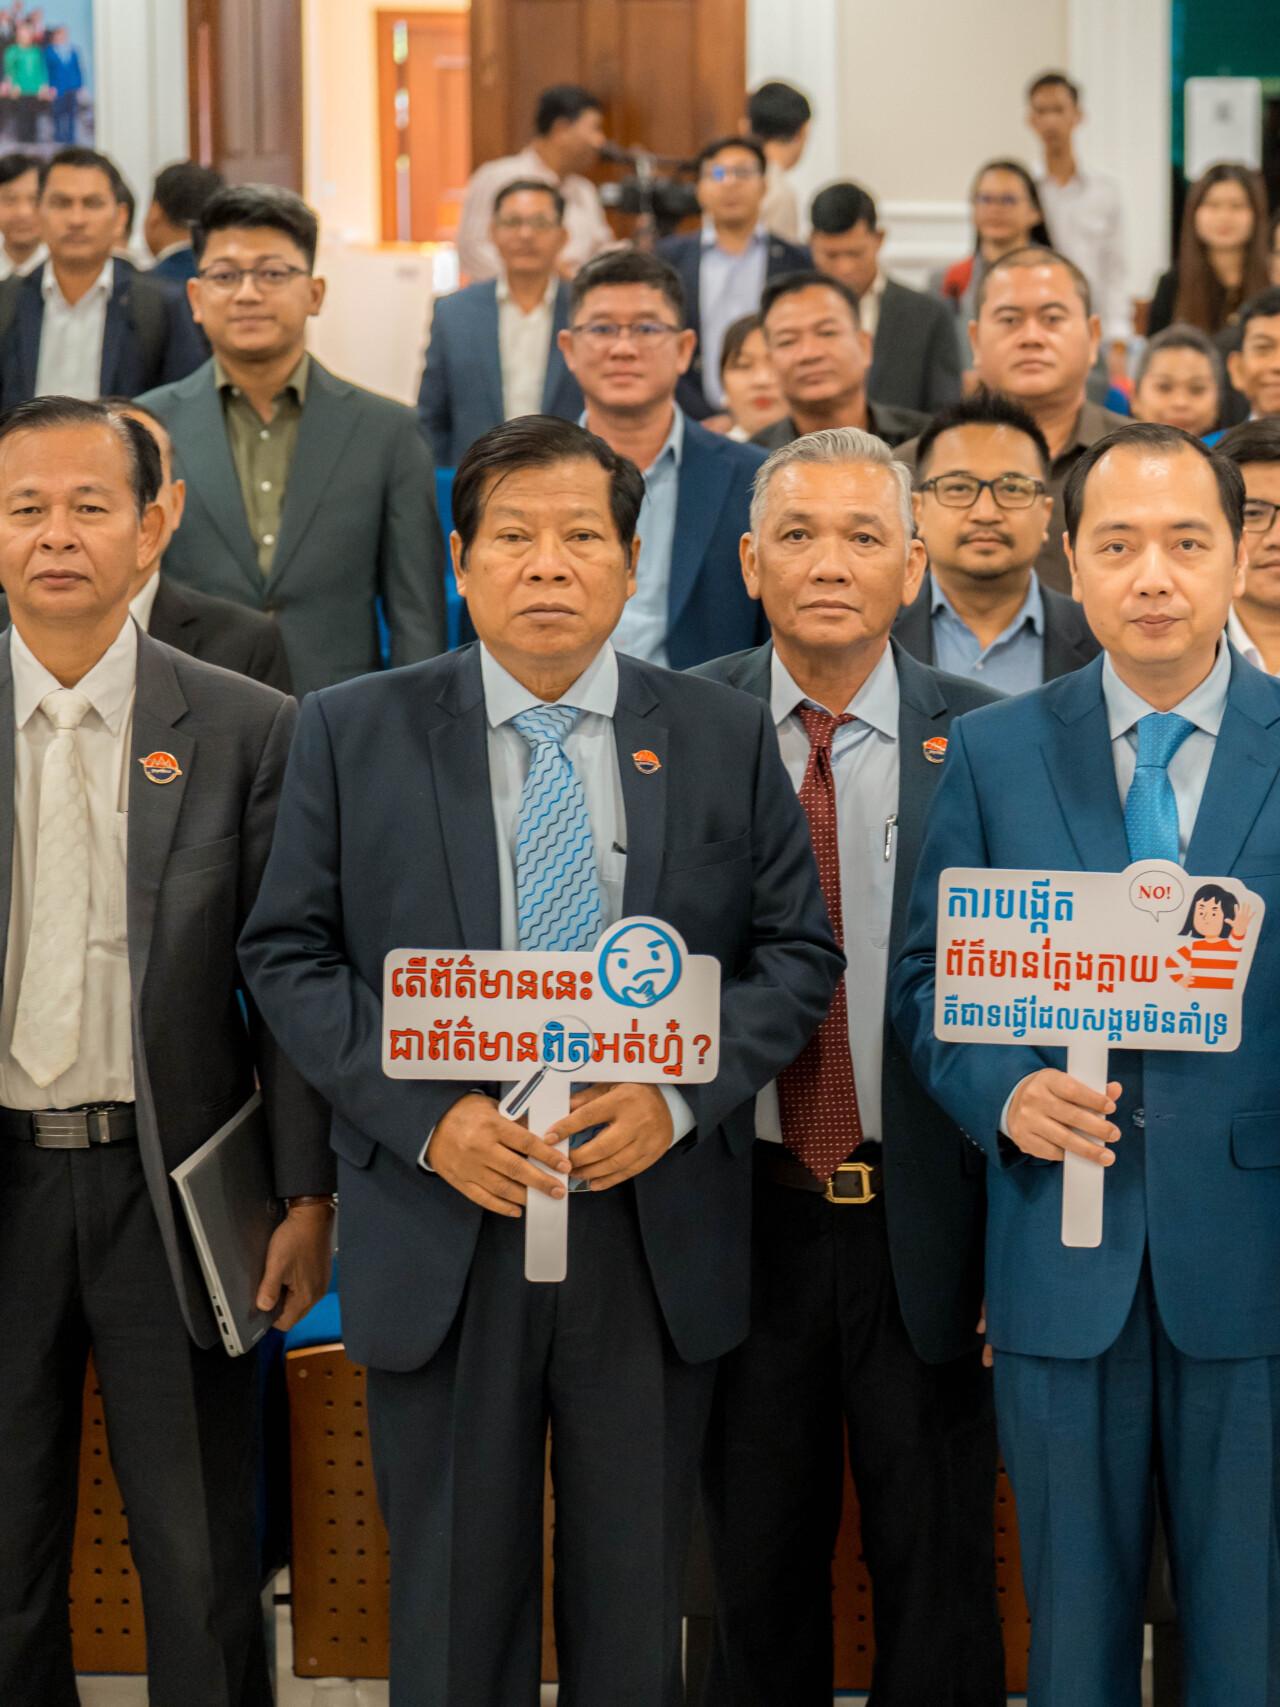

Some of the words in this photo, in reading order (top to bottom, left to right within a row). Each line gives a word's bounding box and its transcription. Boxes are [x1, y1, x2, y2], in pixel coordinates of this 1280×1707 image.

[948, 880, 1072, 934] ការបង្កើត
[1138, 884, 1172, 900] NO!
[392, 955, 592, 1000] តើព័ត៌មាននេះ
